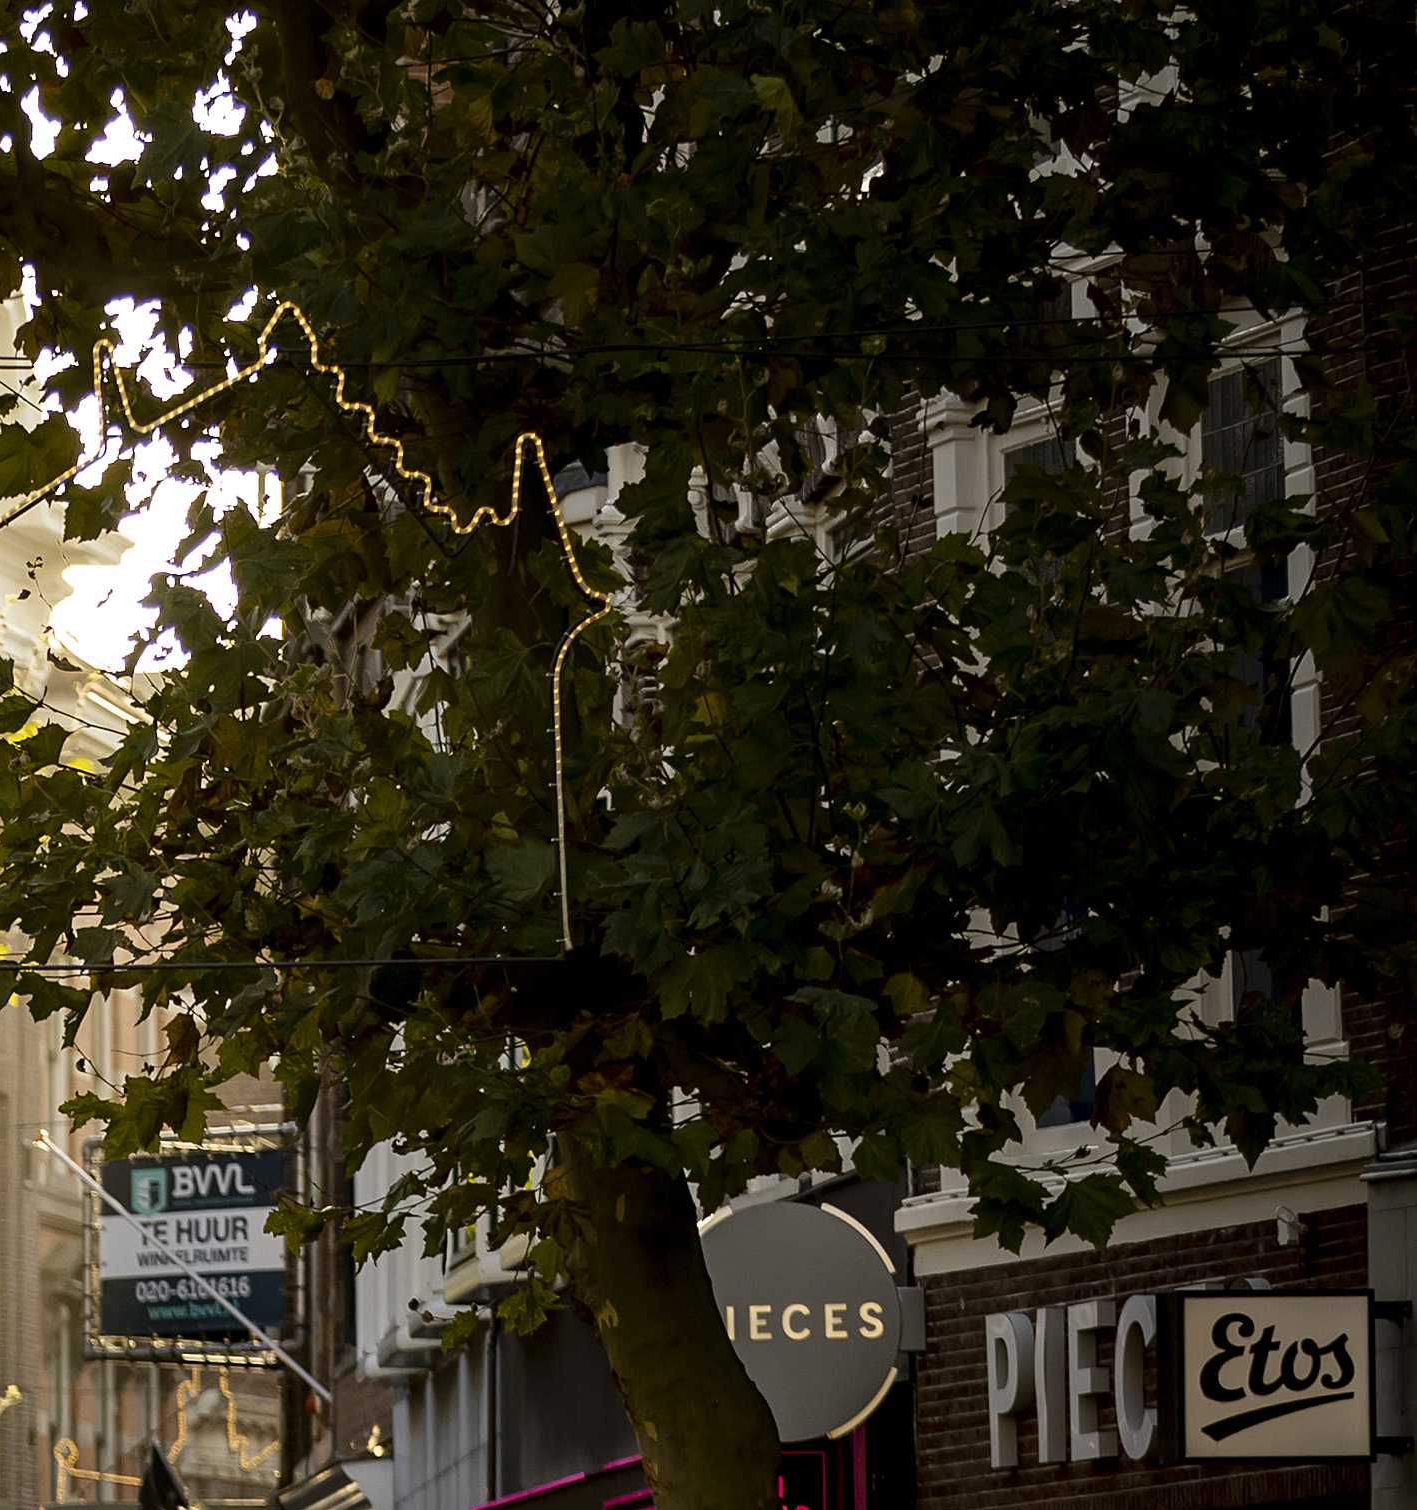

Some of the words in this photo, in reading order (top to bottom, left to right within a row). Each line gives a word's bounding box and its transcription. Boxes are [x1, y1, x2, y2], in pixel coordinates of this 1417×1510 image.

[175, 1216, 248, 1244] HUUR
[725, 1302, 885, 1342] IECES
[985, 1294, 1158, 1469] PIEC
[1199, 1312, 1355, 1403] Etos
